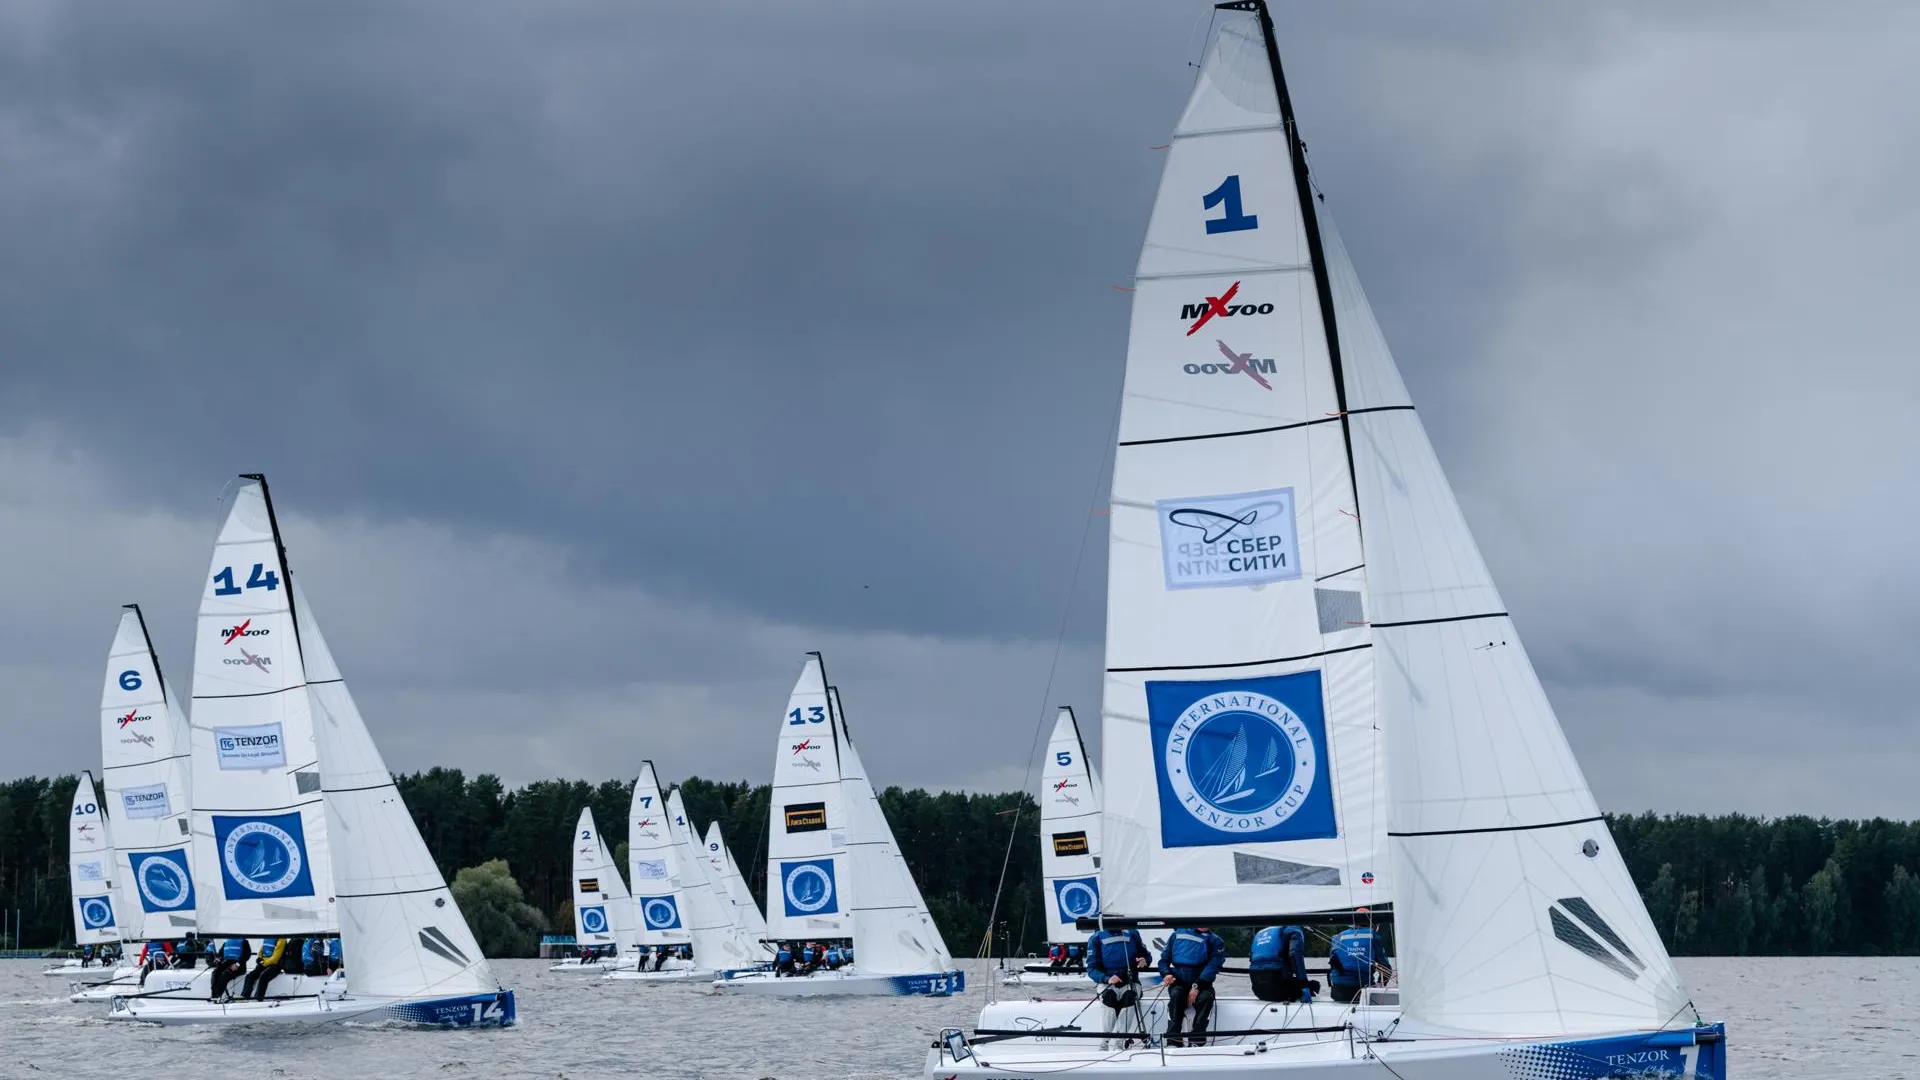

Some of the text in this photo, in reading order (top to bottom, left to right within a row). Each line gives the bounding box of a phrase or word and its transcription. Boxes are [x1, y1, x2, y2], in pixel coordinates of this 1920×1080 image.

[1203, 175, 1258, 234] 1
[1180, 280, 1274, 336] MX700
[1227, 535, 1281, 554] СБЕР
[1229, 553, 1286, 572] СИТИ
[213, 563, 279, 596] 14
[221, 618, 270, 645] MX700
[119, 670, 142, 691] 6
[789, 707, 825, 725] 13
[1171, 696, 1307, 754] INTERNATIONAL
[234, 735, 278, 746] TENZOR
[1056, 751, 1072, 766] 5
[135, 792, 164, 802] TENZOR
[640, 796, 652, 809] 7
[75, 803, 96, 815] 10
[1185, 785, 1304, 828] TENZOR CUP
[227, 824, 295, 854] INTERNATIONAL
[582, 830, 591, 840] 2
[710, 843, 719, 851] 9
[929, 978, 947, 992] 13
[436, 1005, 469, 1014] TENZOR
[471, 1001, 504, 1022] 14
[1606, 1050, 1670, 1066] TENZOR
